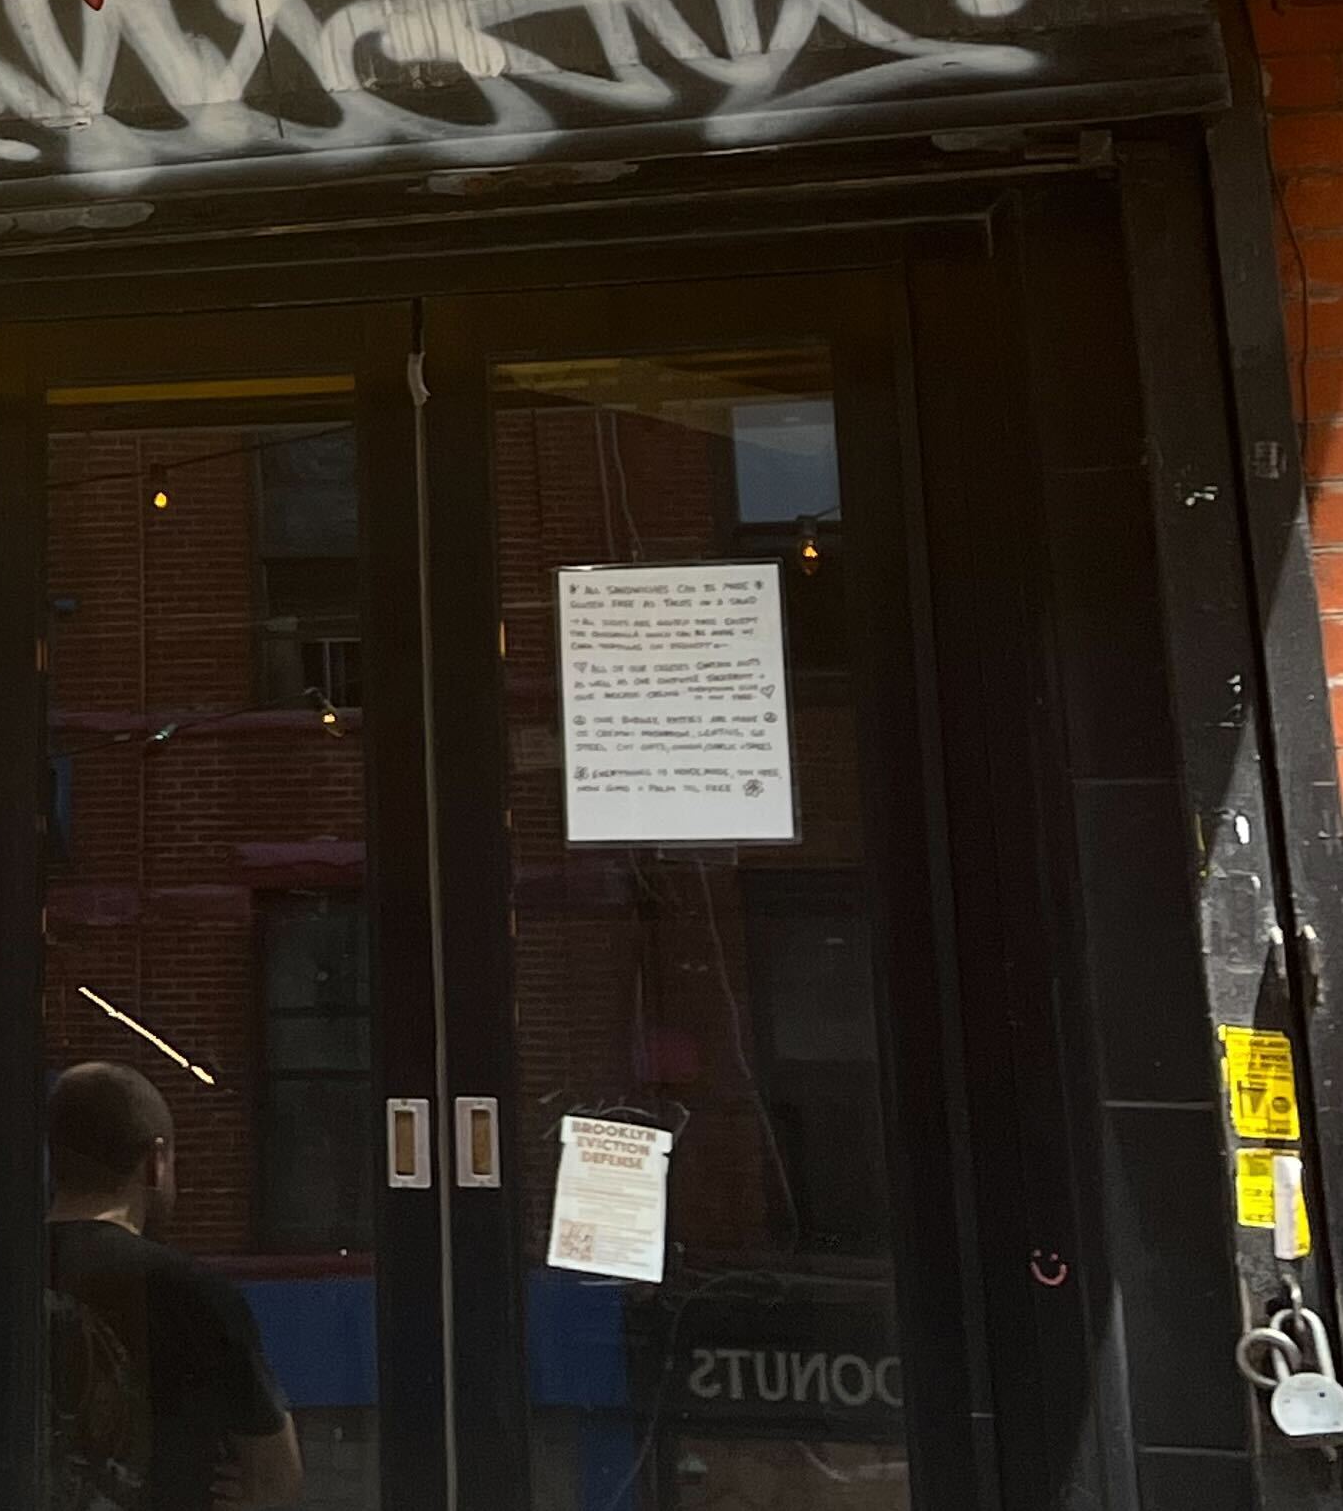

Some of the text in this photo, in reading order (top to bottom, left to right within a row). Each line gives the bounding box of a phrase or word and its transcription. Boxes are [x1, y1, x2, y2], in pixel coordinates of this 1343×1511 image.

[572, 1120, 657, 1143] BROOKLYN
[576, 1136, 651, 1156] EVICTION
[581, 1151, 645, 1170] DEFENSE
